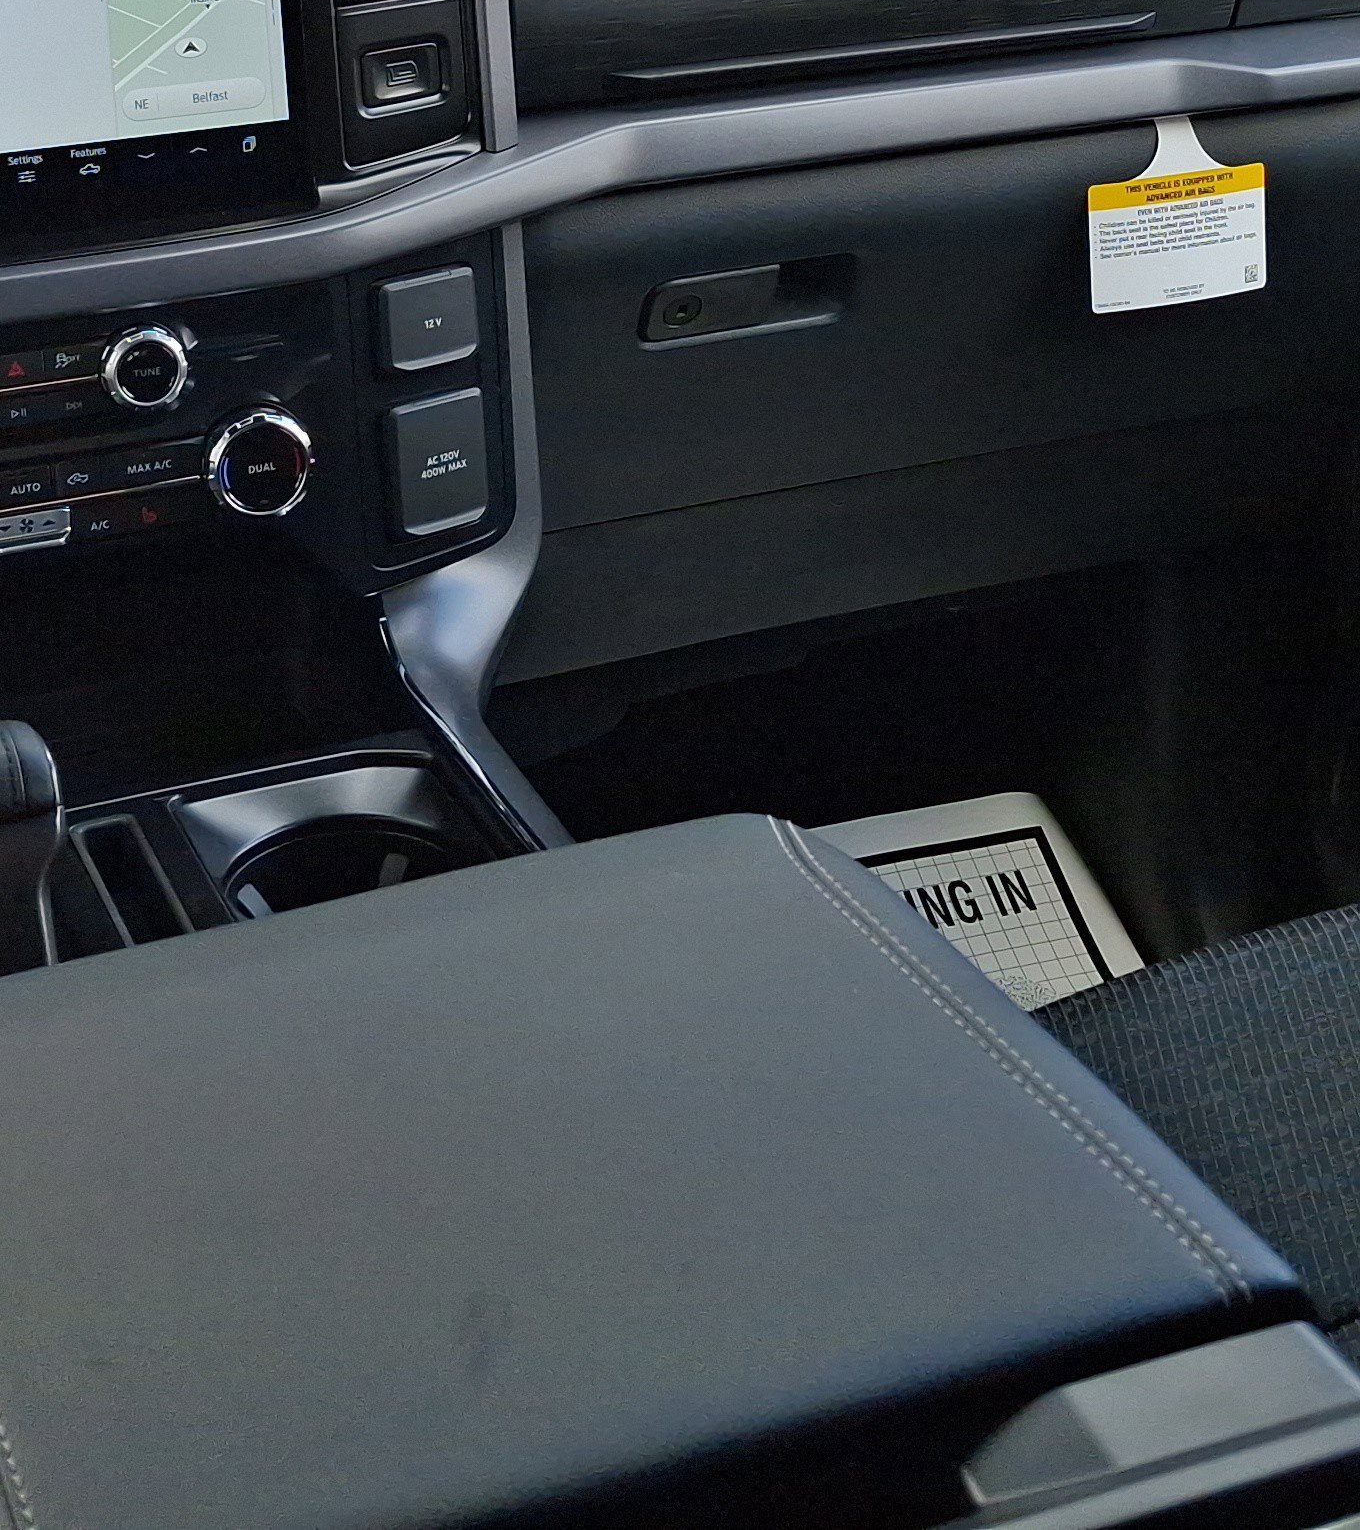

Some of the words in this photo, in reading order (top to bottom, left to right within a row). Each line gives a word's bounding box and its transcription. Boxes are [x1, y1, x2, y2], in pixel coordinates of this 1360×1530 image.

[135, 99, 149, 110] NE
[193, 91, 228, 104] Belfast
[71, 147, 106, 158] Features
[8, 154, 43, 166] Settings
[424, 320, 434, 329] 12
[434, 318, 442, 327] V
[134, 366, 161, 378] TUNE
[427, 455, 438, 467] AC
[440, 450, 460, 463] 120V
[127, 462, 152, 474] MAX
[154, 459, 172, 470] A/C
[248, 461, 276, 474] DUAL
[421, 466, 446, 480] 400W
[448, 459, 467, 471] MAX
[11, 482, 41, 495] AUTO
[90, 519, 109, 531] A/C
[985, 869, 1037, 917] IN
